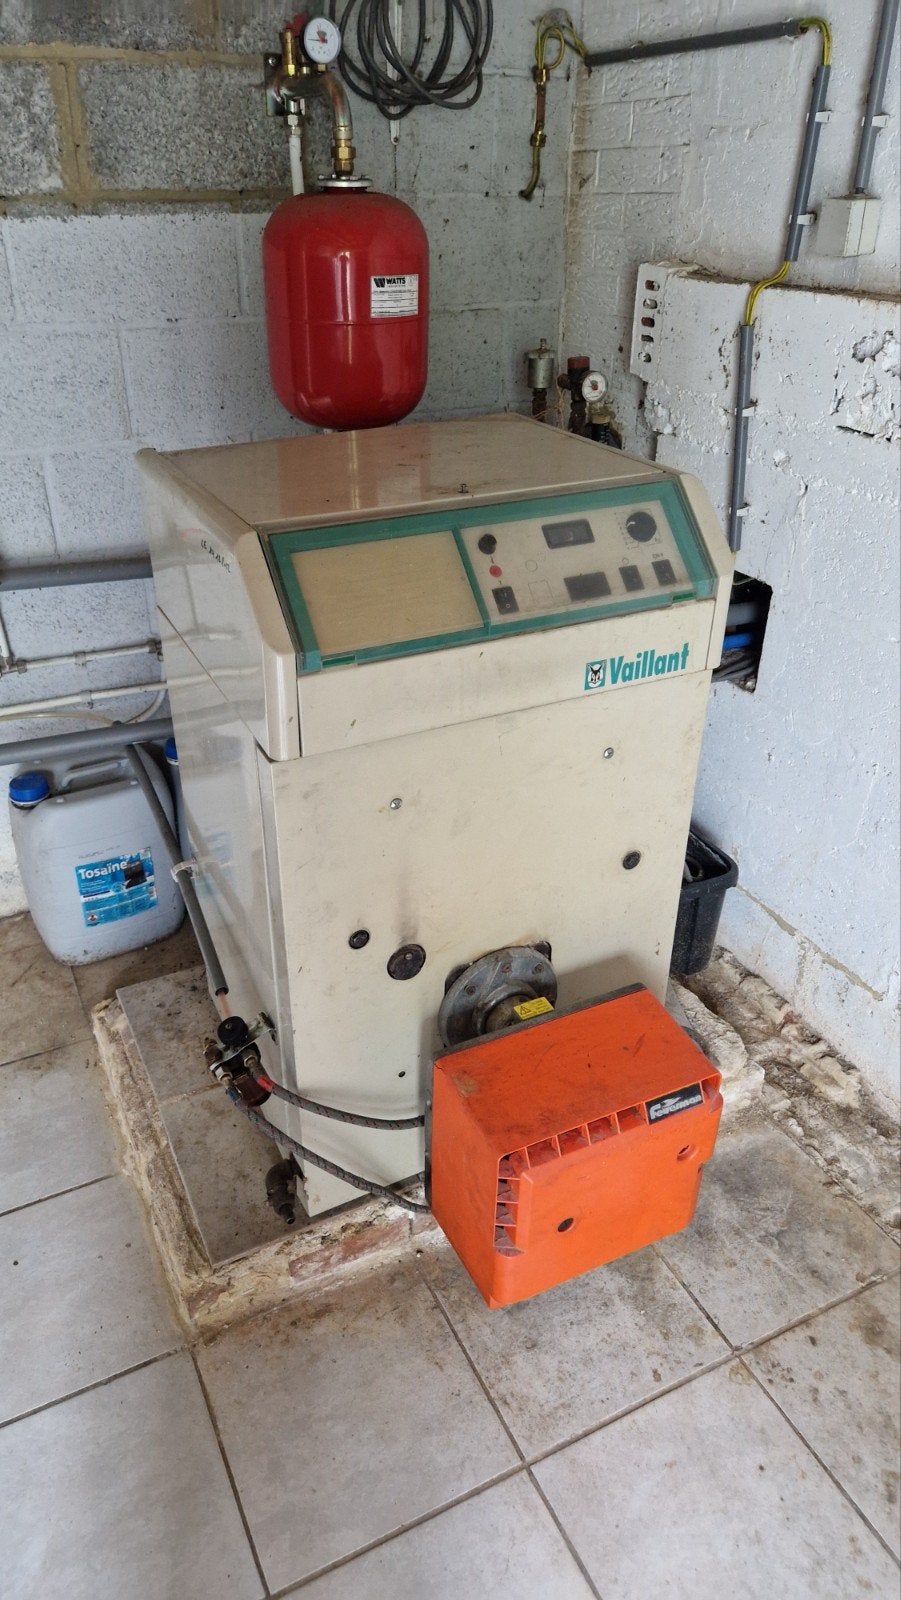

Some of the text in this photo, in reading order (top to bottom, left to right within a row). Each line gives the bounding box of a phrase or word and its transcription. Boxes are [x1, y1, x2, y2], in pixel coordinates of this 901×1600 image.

[386, 277, 406, 285] WATTS
[610, 642, 690, 684] Vaillant
[78, 860, 127, 879] Tosaïne
